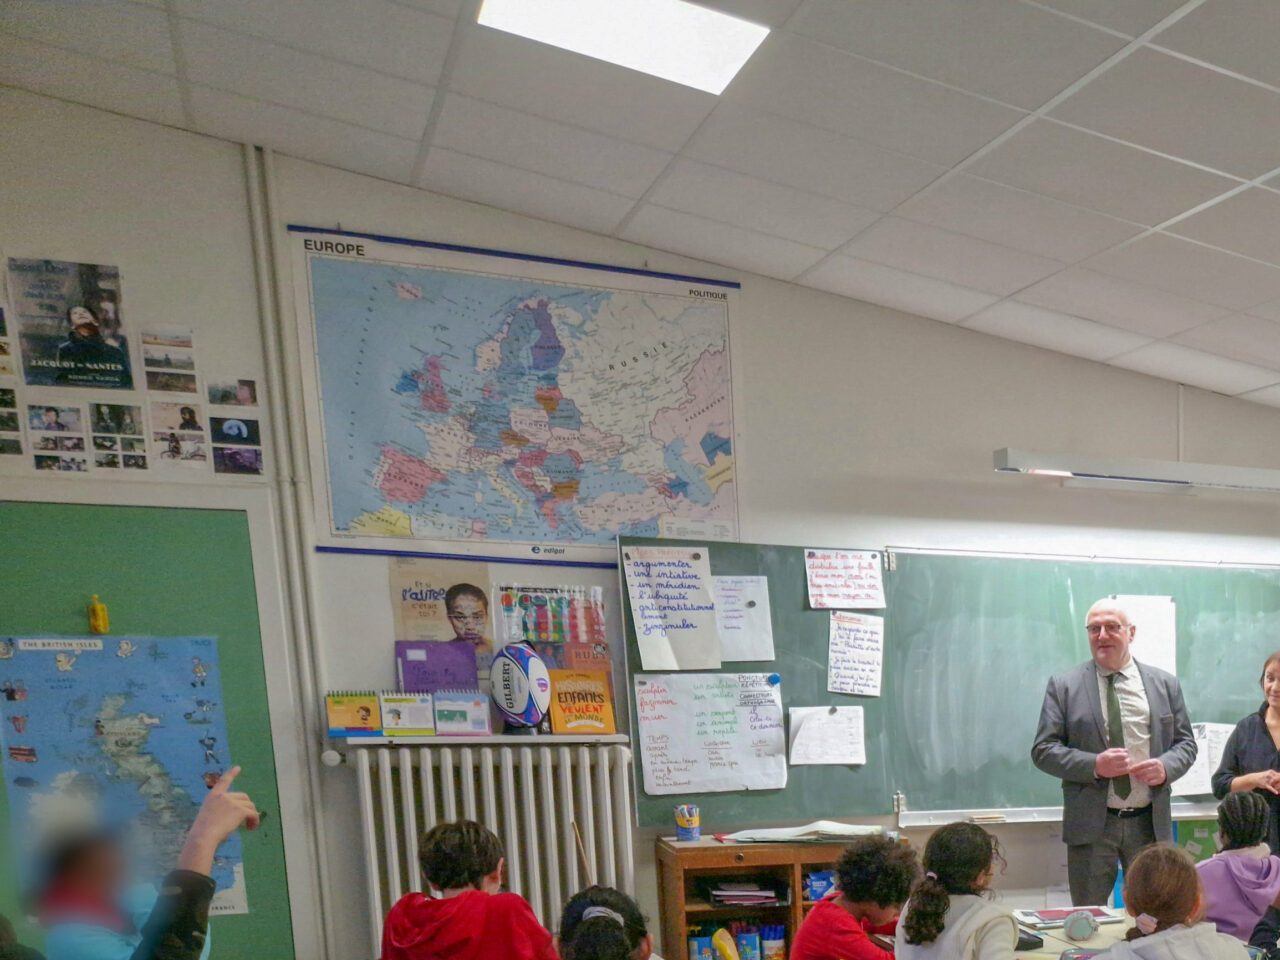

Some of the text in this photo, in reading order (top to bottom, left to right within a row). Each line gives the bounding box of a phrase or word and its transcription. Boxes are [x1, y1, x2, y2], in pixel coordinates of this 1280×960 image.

[304, 238, 365, 256] EUROPE
[689, 289, 728, 300] POLITIQUE
[608, 341, 668, 371] RUSSIE
[30, 359, 75, 368] JACQUOT
[634, 559, 692, 572] argumenter
[656, 581, 700, 589] méridien
[503, 661, 514, 709] GILBERT
[560, 705, 605, 714] VEULENT
